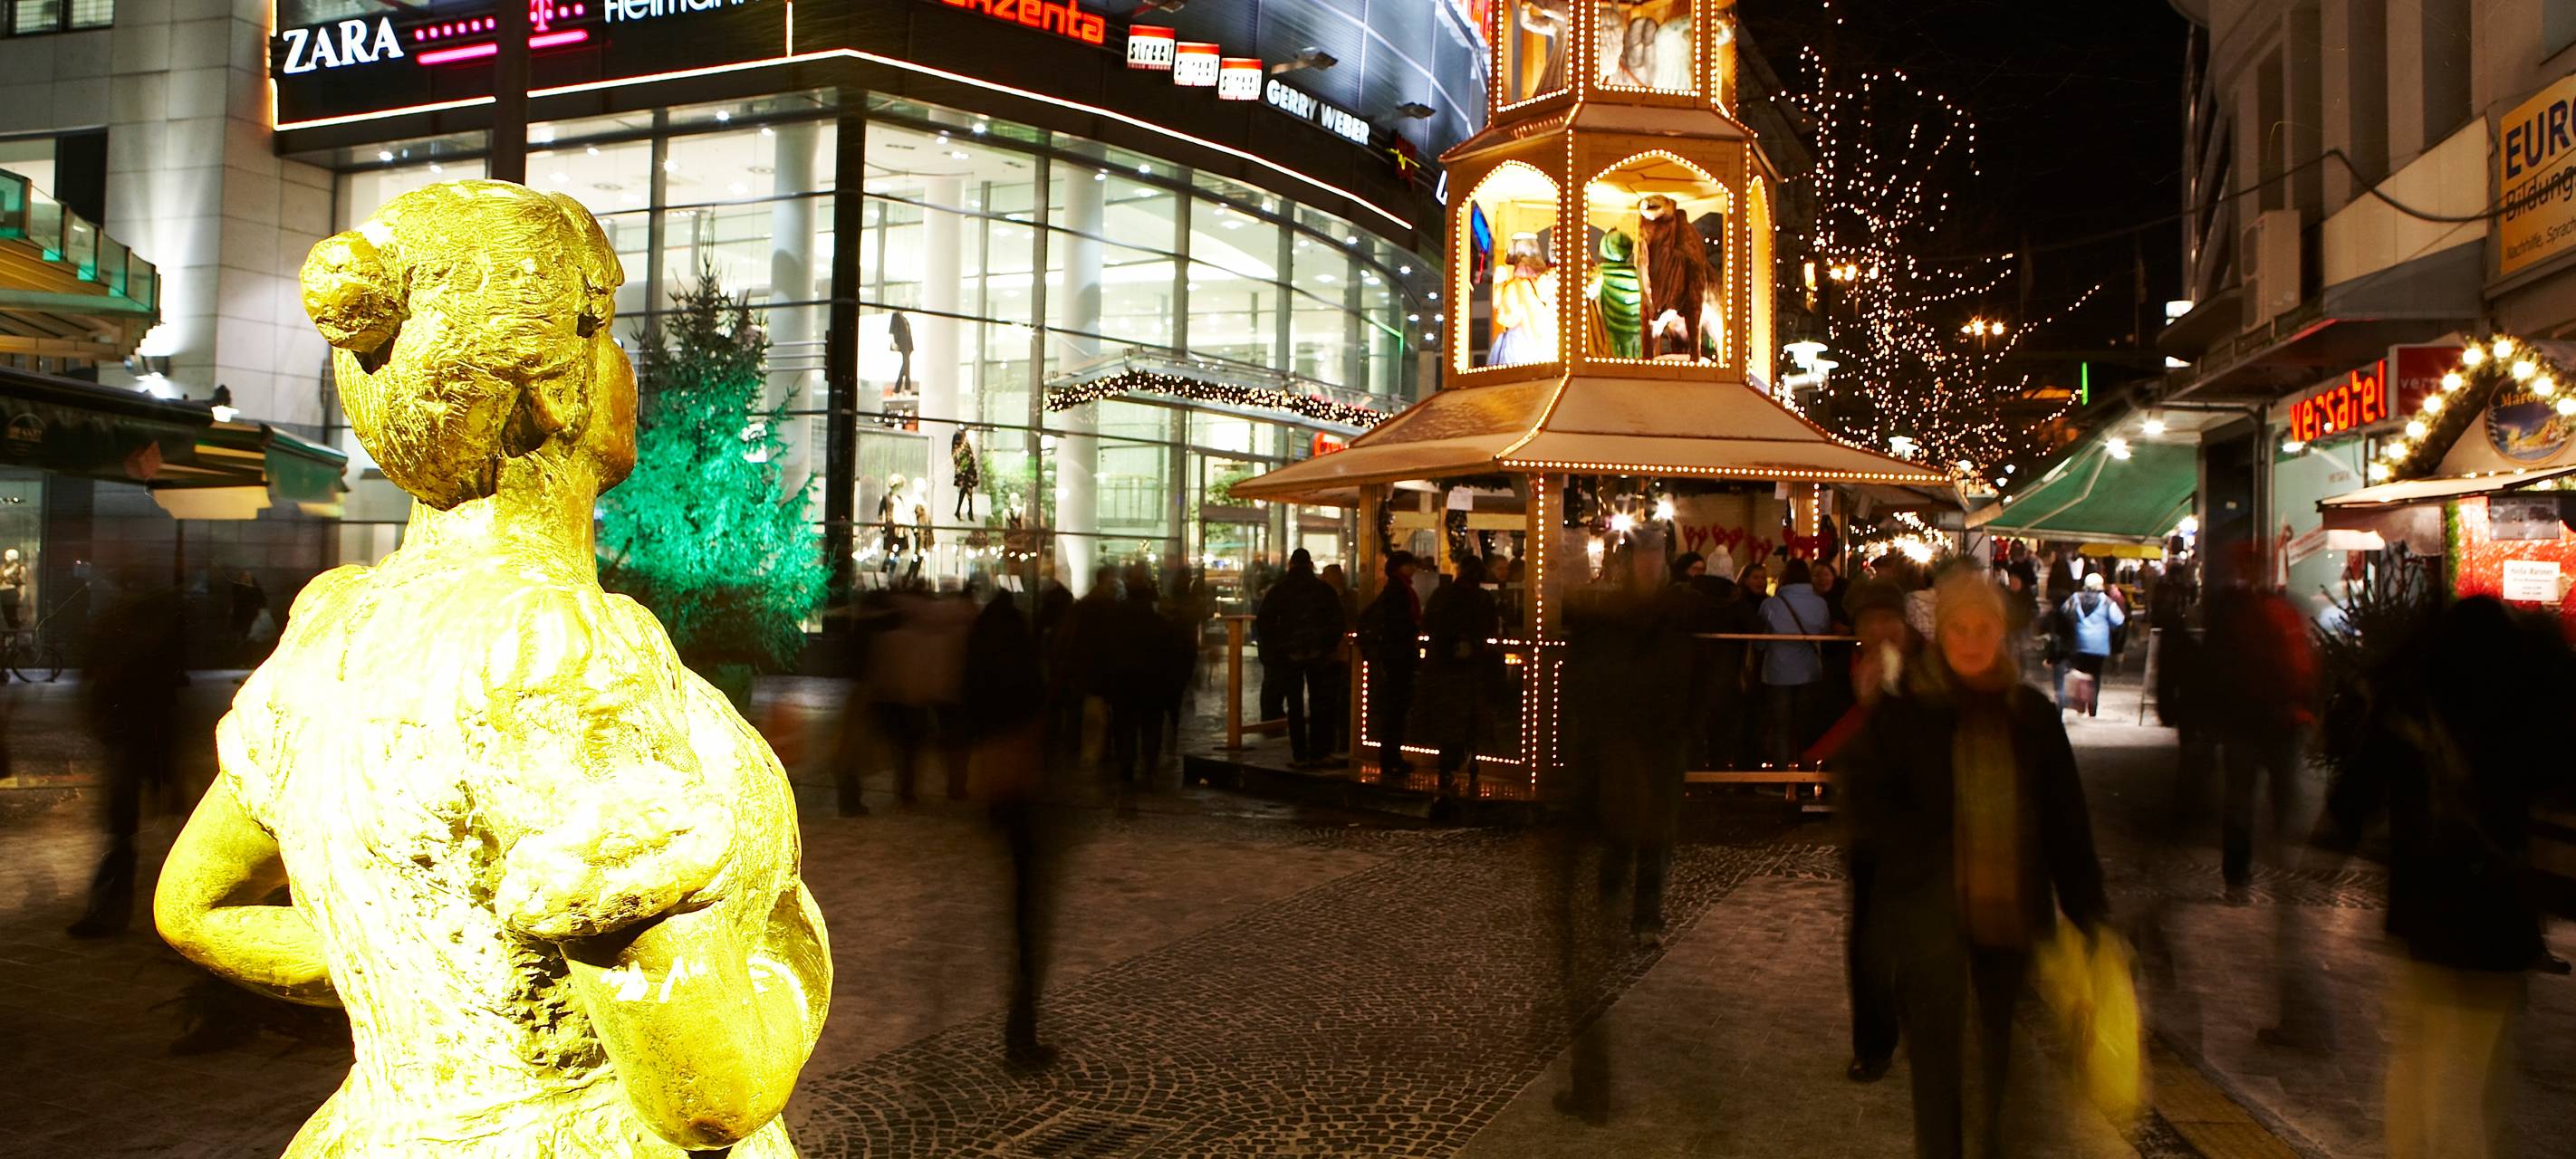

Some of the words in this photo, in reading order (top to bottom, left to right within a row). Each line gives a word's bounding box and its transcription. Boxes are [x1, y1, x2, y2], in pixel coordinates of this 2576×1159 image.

[283, 16, 405, 74] ZARA
[942, 0, 1105, 44] zenta
[1130, 41, 1172, 62] street
[1177, 58, 1216, 77] sreet
[1222, 74, 1260, 91] sreet
[1266, 79, 1319, 120] GERRY
[1321, 102, 1370, 146] WEBER
[2506, 98, 2576, 180] EUR
[2290, 359, 2387, 443] versatel
